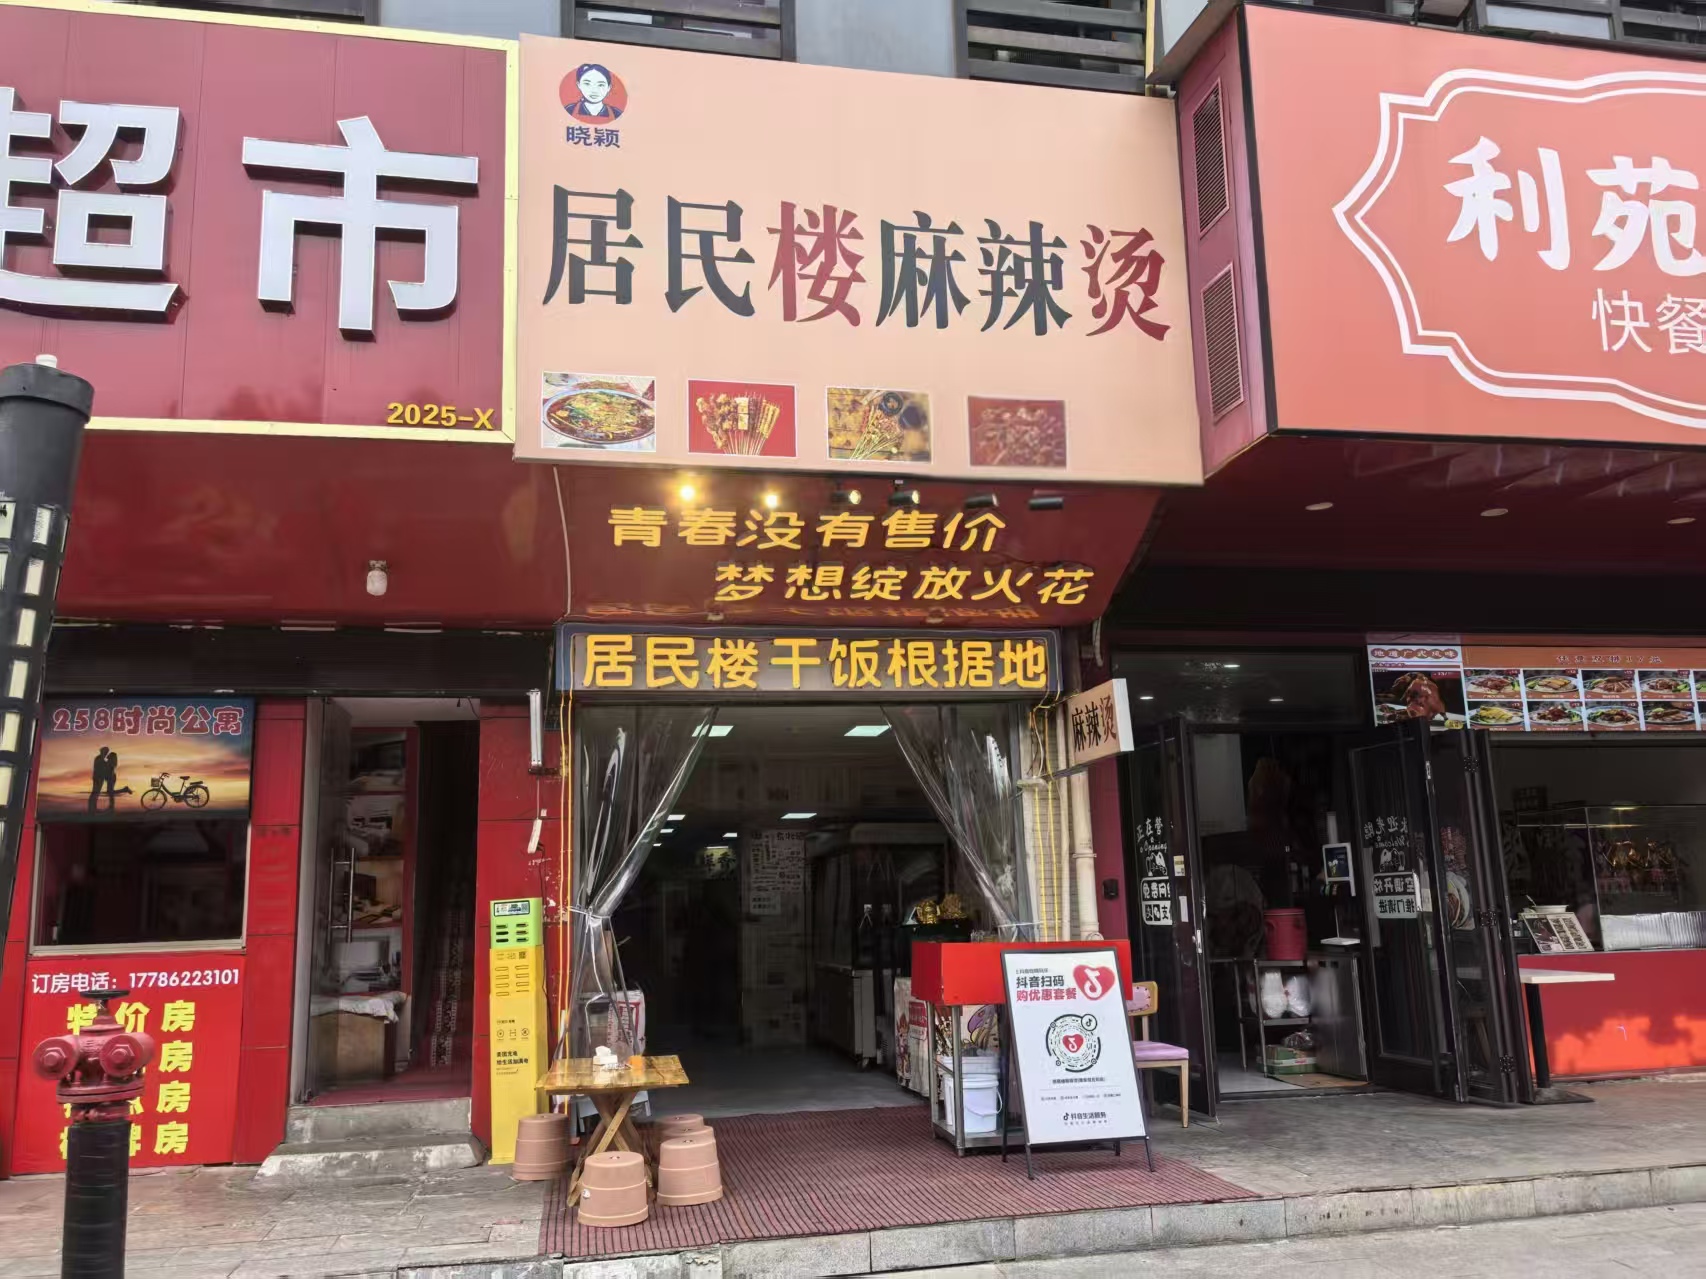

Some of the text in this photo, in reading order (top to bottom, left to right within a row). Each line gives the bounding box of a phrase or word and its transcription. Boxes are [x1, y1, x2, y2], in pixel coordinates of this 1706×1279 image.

[566, 126, 620, 149] 晓颖
[1443, 135, 1706, 277] 利苑
[542, 183, 1172, 342] 居民楼麻辣烫
[1591, 287, 1706, 355] 快餐
[387, 402, 495, 430] 2025-X
[607, 506, 1007, 552] 青春没有售价
[713, 563, 1095, 605] 梦想绽放火花
[583, 634, 1048, 690] 居民楼干饭根据地
[53, 705, 244, 736] 258时尚公寓
[1071, 695, 1117, 753] 麻辣烫
[1016, 975, 1064, 989] 抖音扫码
[1016, 987, 1077, 1002] 购优惠套餐
